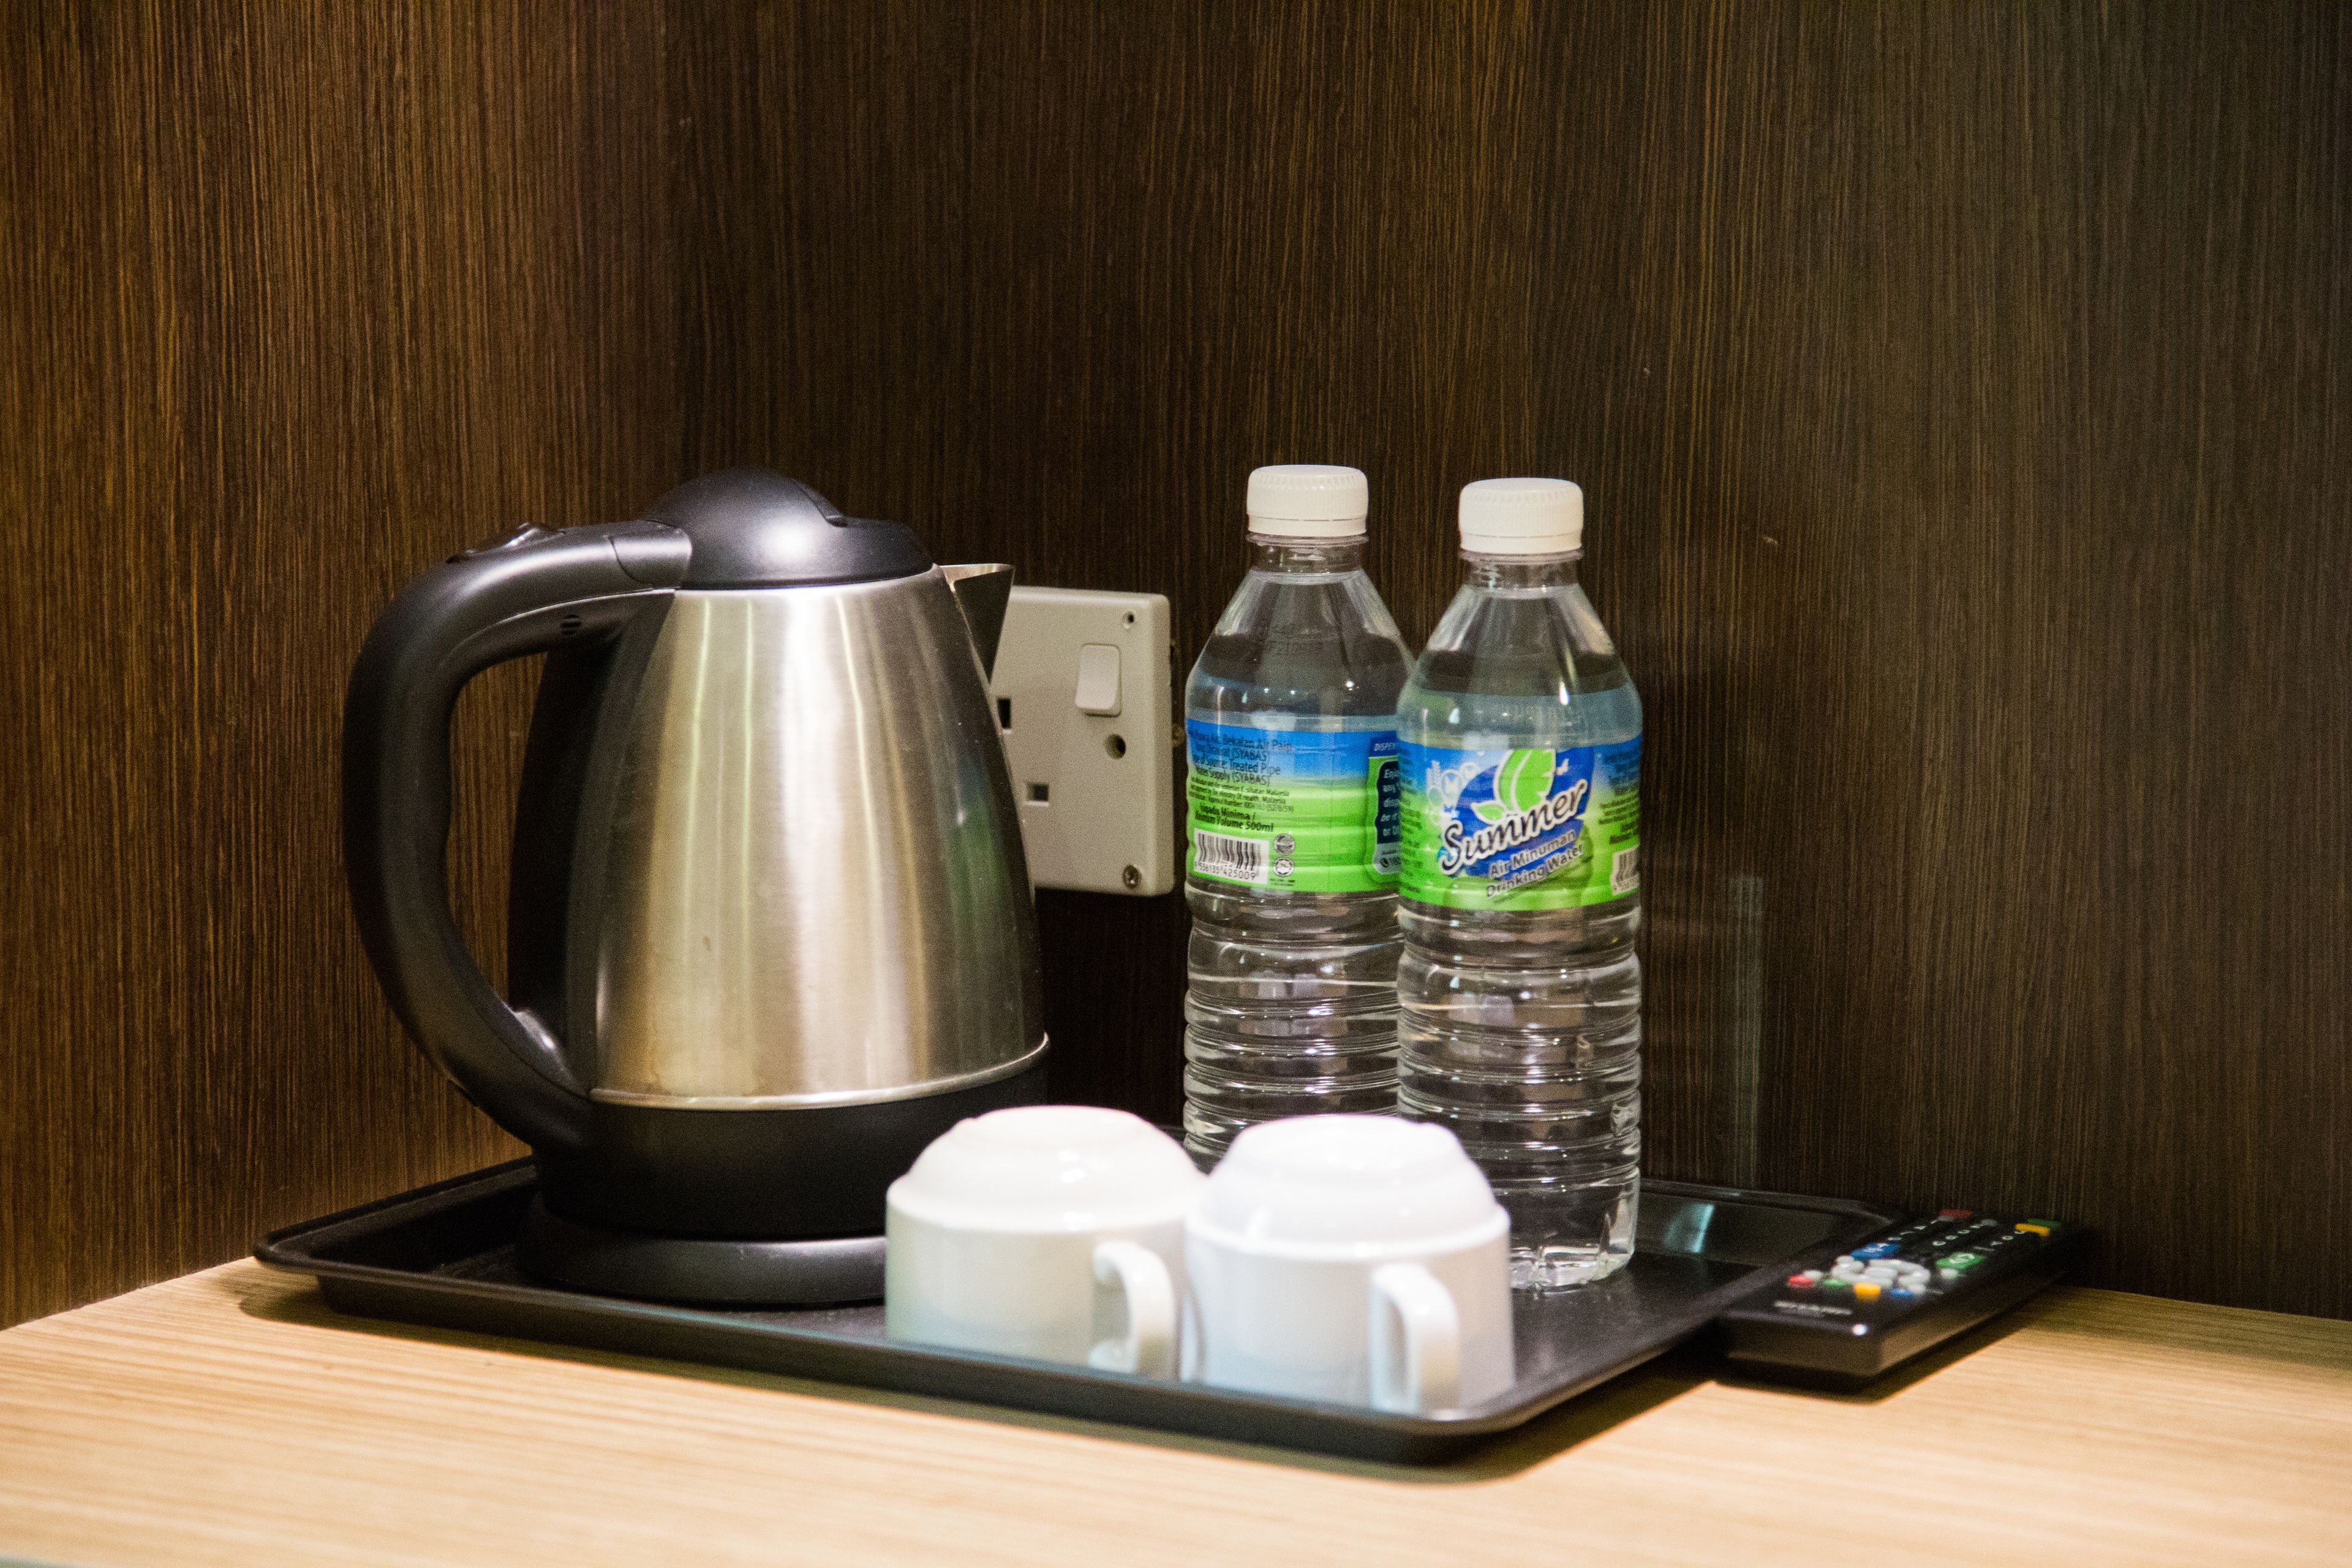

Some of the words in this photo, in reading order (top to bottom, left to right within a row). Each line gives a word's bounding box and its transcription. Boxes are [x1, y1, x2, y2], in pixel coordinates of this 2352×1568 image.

[1229, 758, 1259, 773] Treated
[1261, 765, 1281, 777] Pipe
[1232, 771, 1270, 787] (SYABAS)
[1221, 807, 1251, 820] Minima
[1217, 814, 1243, 829] Volume
[1246, 821, 1274, 833] 500ml
[1440, 780, 1588, 873] Summer
[1489, 860, 1510, 879] Air
[1511, 831, 1576, 870] Minuman
[1486, 864, 1545, 898] Drinking
[1547, 843, 1583, 873] Water
